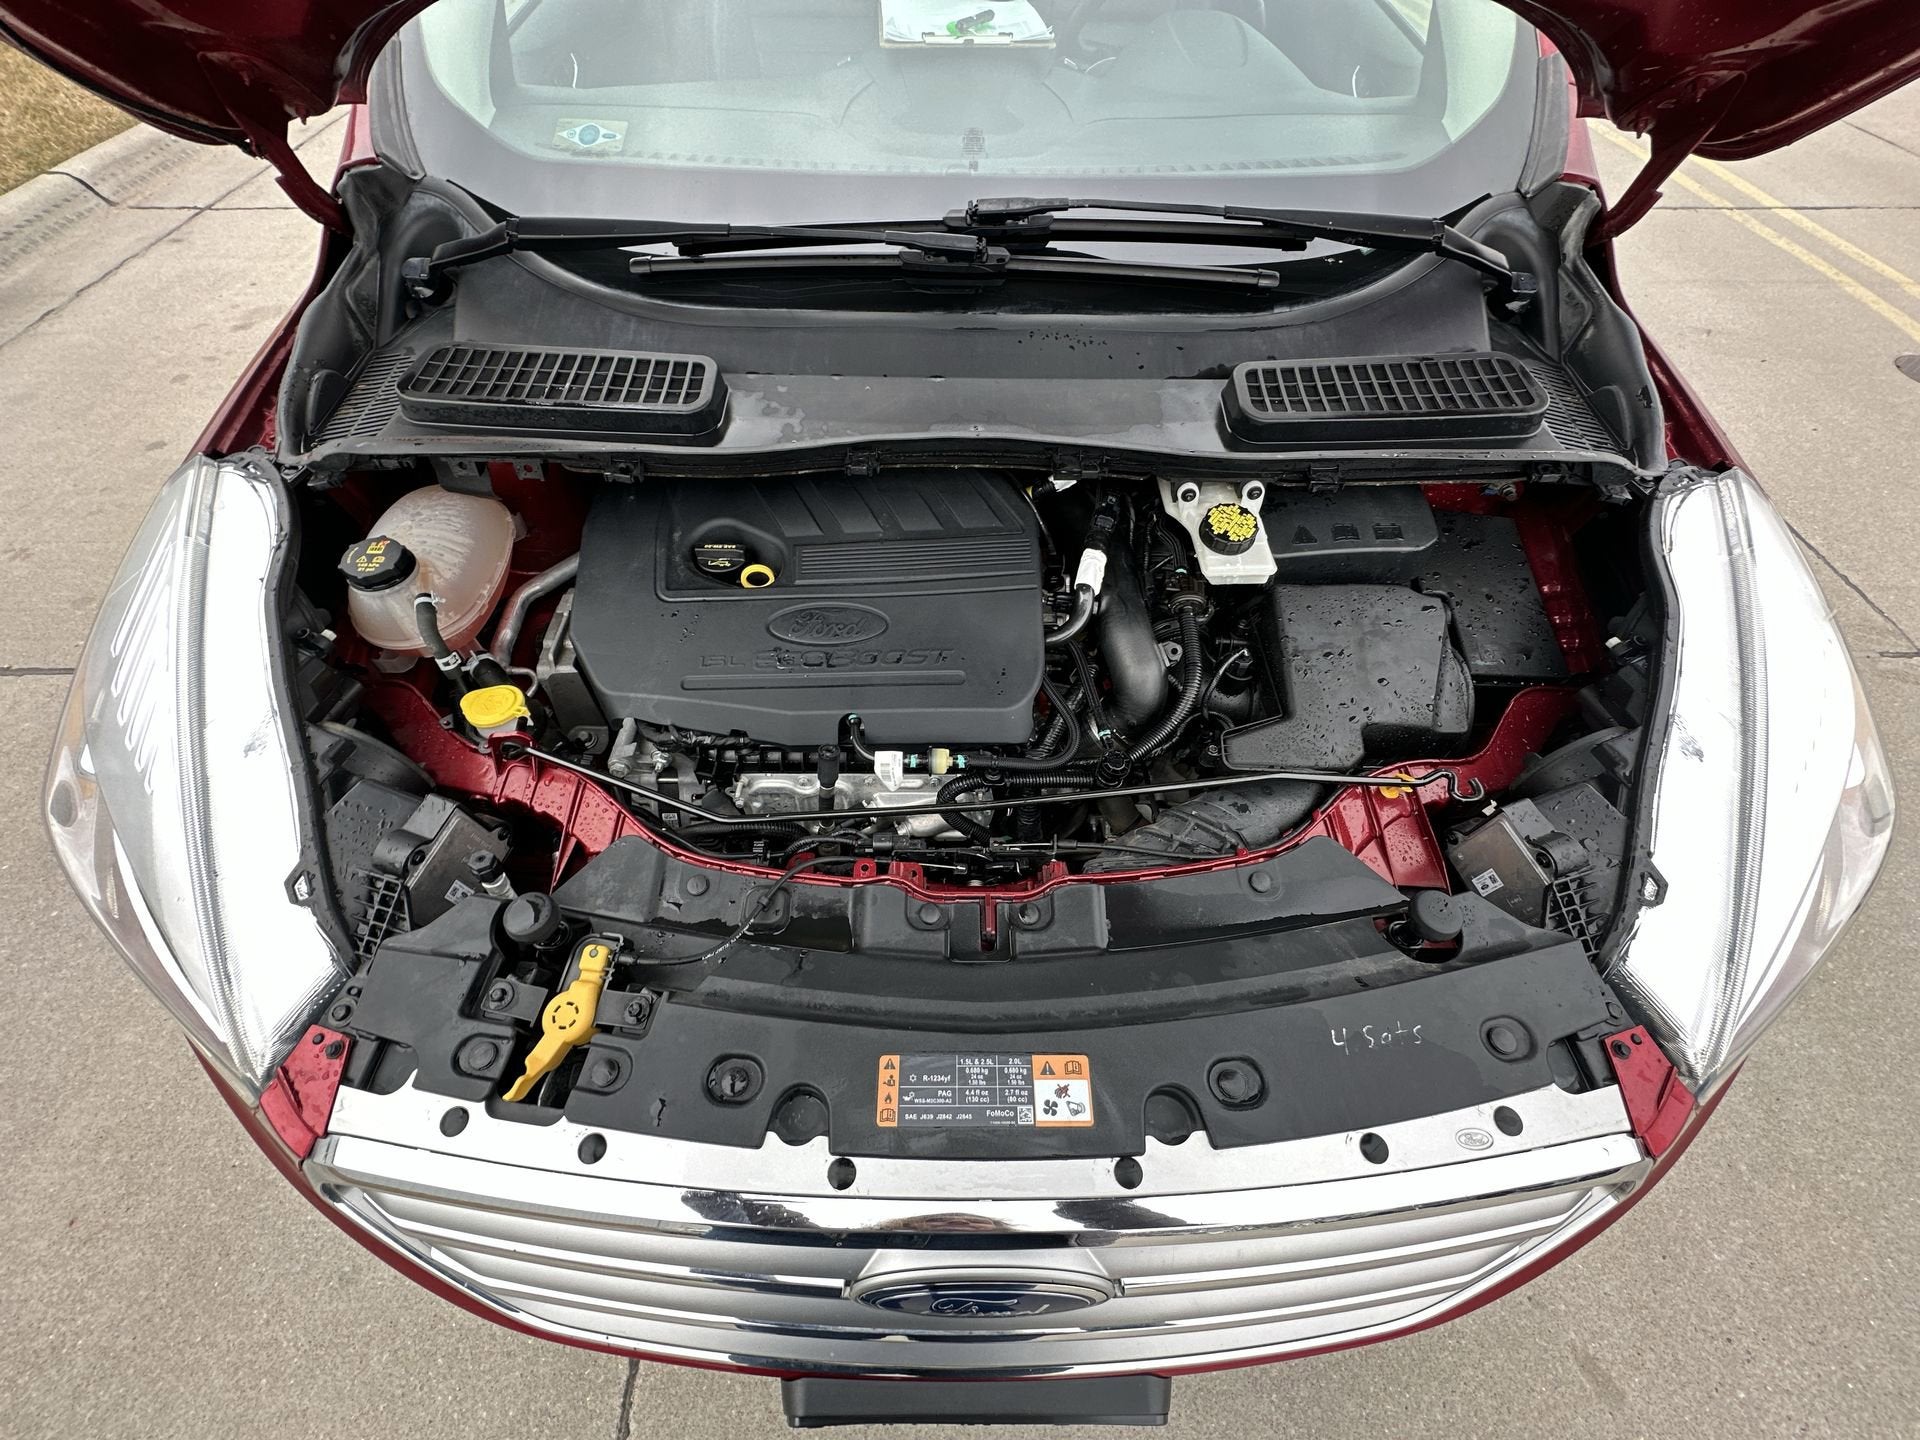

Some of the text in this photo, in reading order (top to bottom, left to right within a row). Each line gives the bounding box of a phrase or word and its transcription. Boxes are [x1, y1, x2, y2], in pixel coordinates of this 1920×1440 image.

[789, 611, 868, 639] Ford
[1331, 1028, 1349, 1055] 4
[922, 1074, 951, 1083] R-1234yf
[986, 1109, 1015, 1117] FoMoCo
